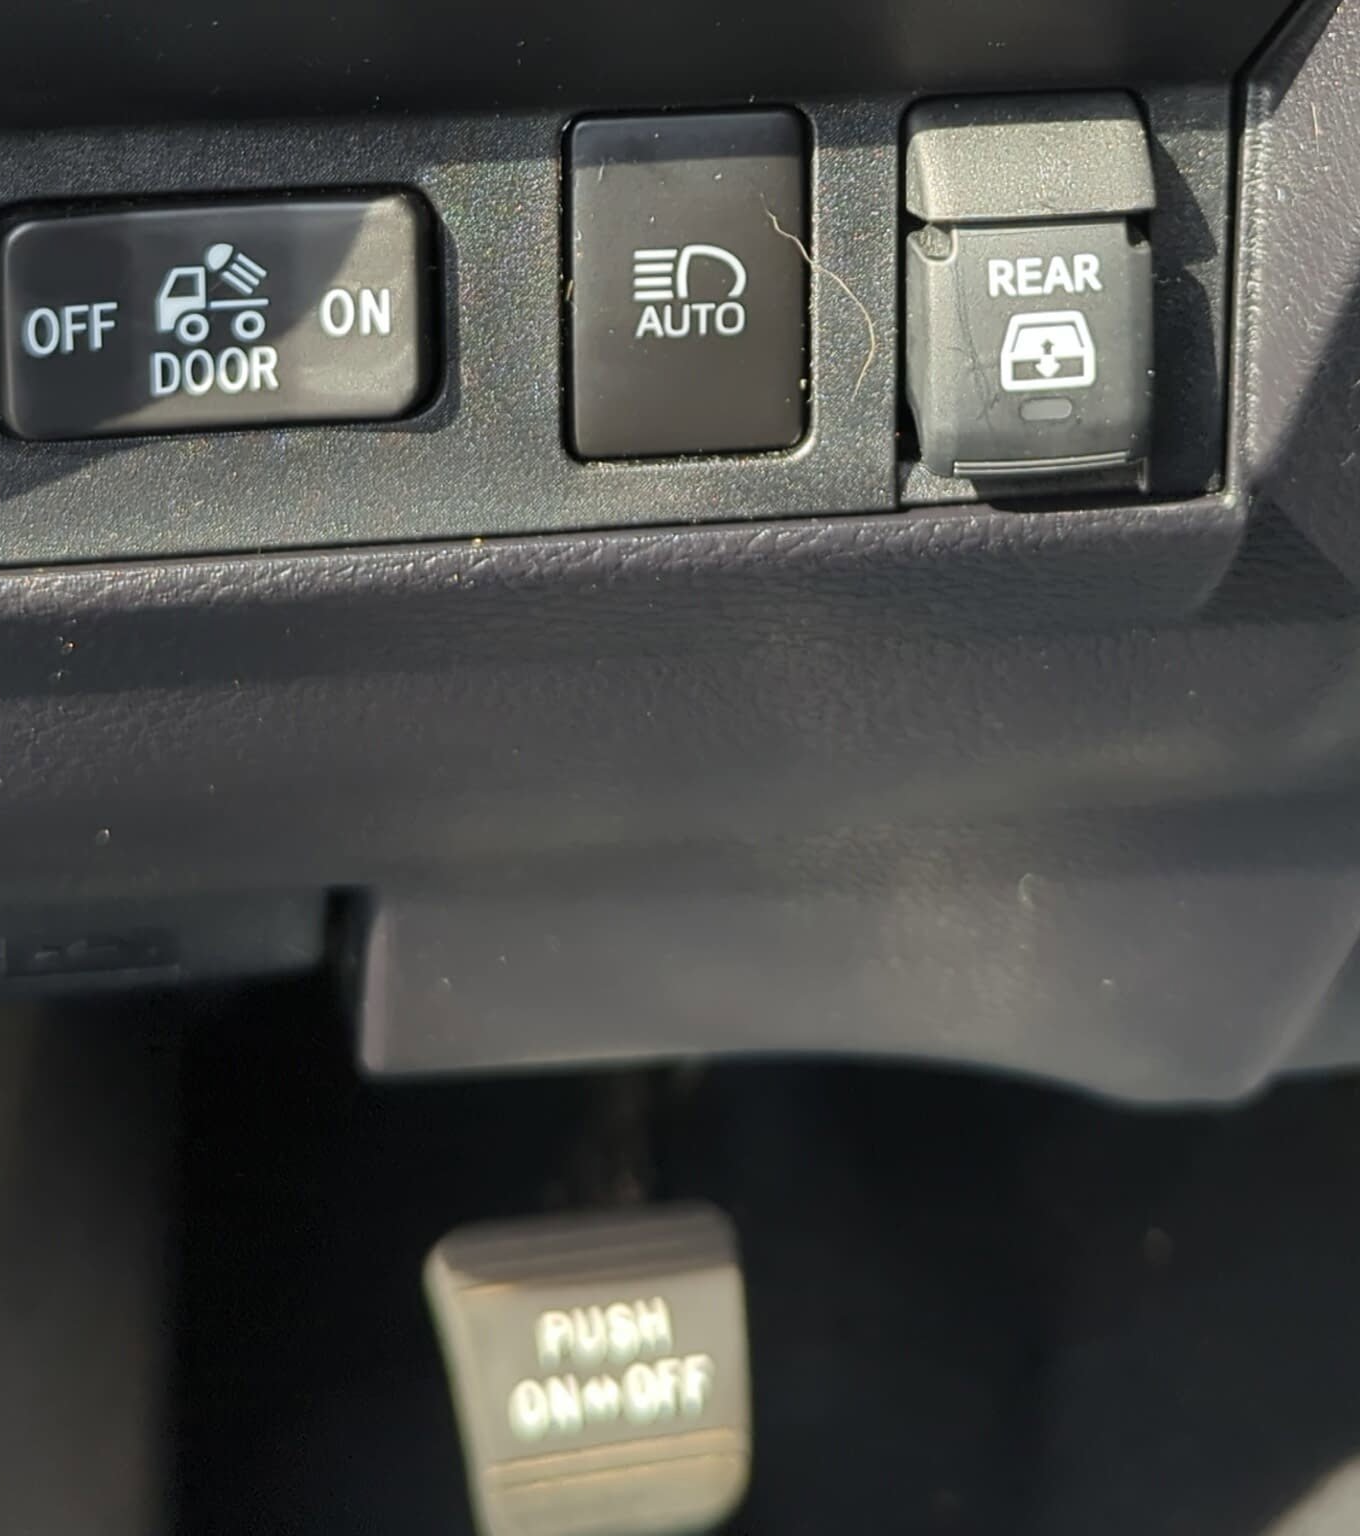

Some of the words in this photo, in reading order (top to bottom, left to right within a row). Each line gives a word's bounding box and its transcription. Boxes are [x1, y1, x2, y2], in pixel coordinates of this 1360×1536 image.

[987, 252, 1103, 298] REAR
[22, 301, 119, 357] OFF
[320, 287, 392, 337] ON
[635, 300, 746, 339] AUTO
[151, 345, 280, 398] DOOR
[535, 1296, 673, 1369] PUSH
